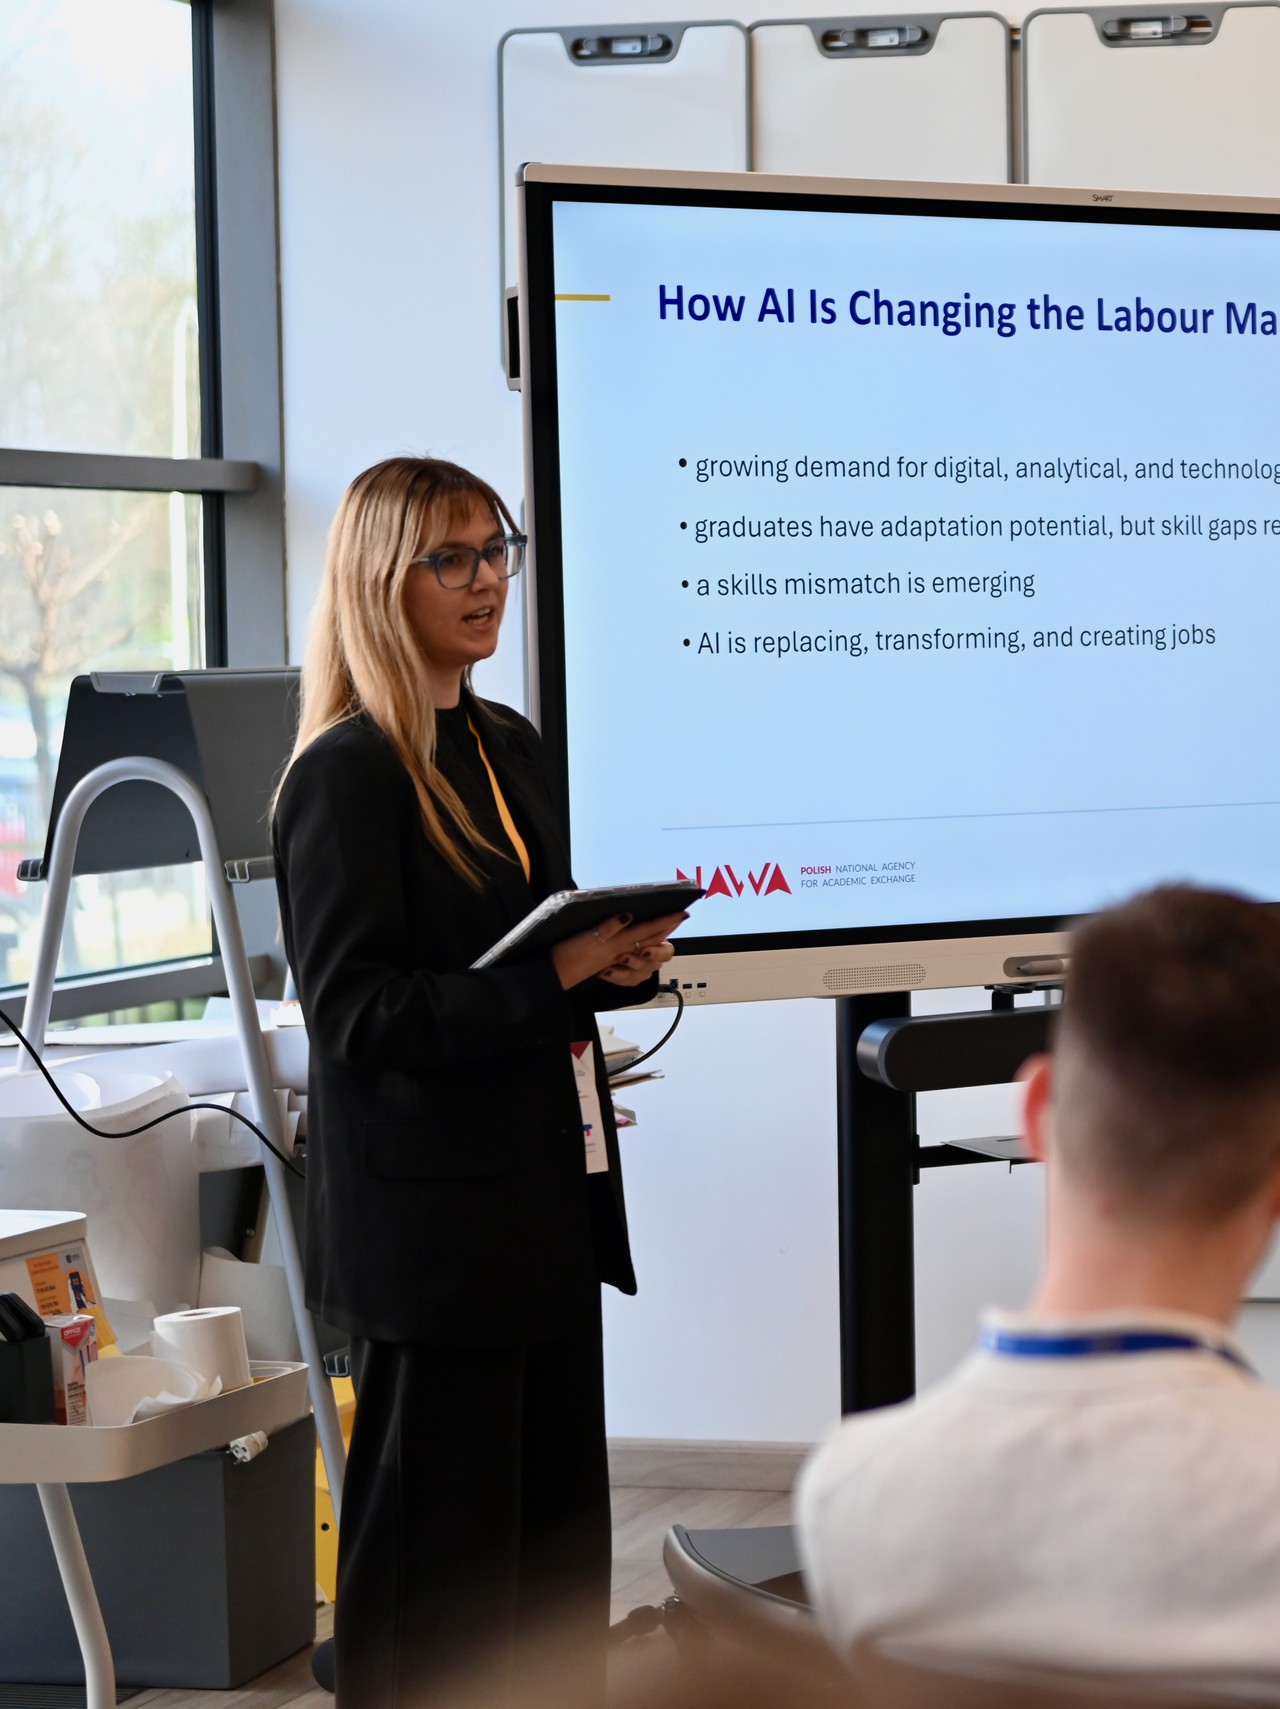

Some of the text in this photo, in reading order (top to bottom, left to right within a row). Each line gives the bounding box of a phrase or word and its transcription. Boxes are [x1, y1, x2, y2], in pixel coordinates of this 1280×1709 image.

[658, 284, 746, 322] How
[757, 287, 795, 324] AI
[809, 288, 837, 325] Is
[848, 288, 1017, 338] Changing
[1026, 293, 1085, 331] the
[1097, 296, 1215, 334] Labour
[695, 454, 789, 484] growing
[794, 455, 890, 478] demand
[896, 455, 929, 478] for
[934, 455, 1009, 484] digital,
[1015, 456, 1128, 484] analytical,
[1134, 457, 1174, 479] and
[694, 515, 813, 544] graduates
[820, 515, 874, 538] have
[880, 514, 1003, 543] adaptation
[1010, 514, 1114, 542] potential,
[1120, 514, 1156, 536] but
[1161, 514, 1204, 536] skill
[1208, 518, 1258, 542] gaps
[696, 570, 1036, 599] a skills mismatch is emerging
[697, 623, 1216, 659] AI is replacing, transforming, and creating jobs
[800, 861, 916, 875] POLISH NATIONAL AGENCY
[801, 874, 916, 888] FOR ACADEMIC EXCHANGE
